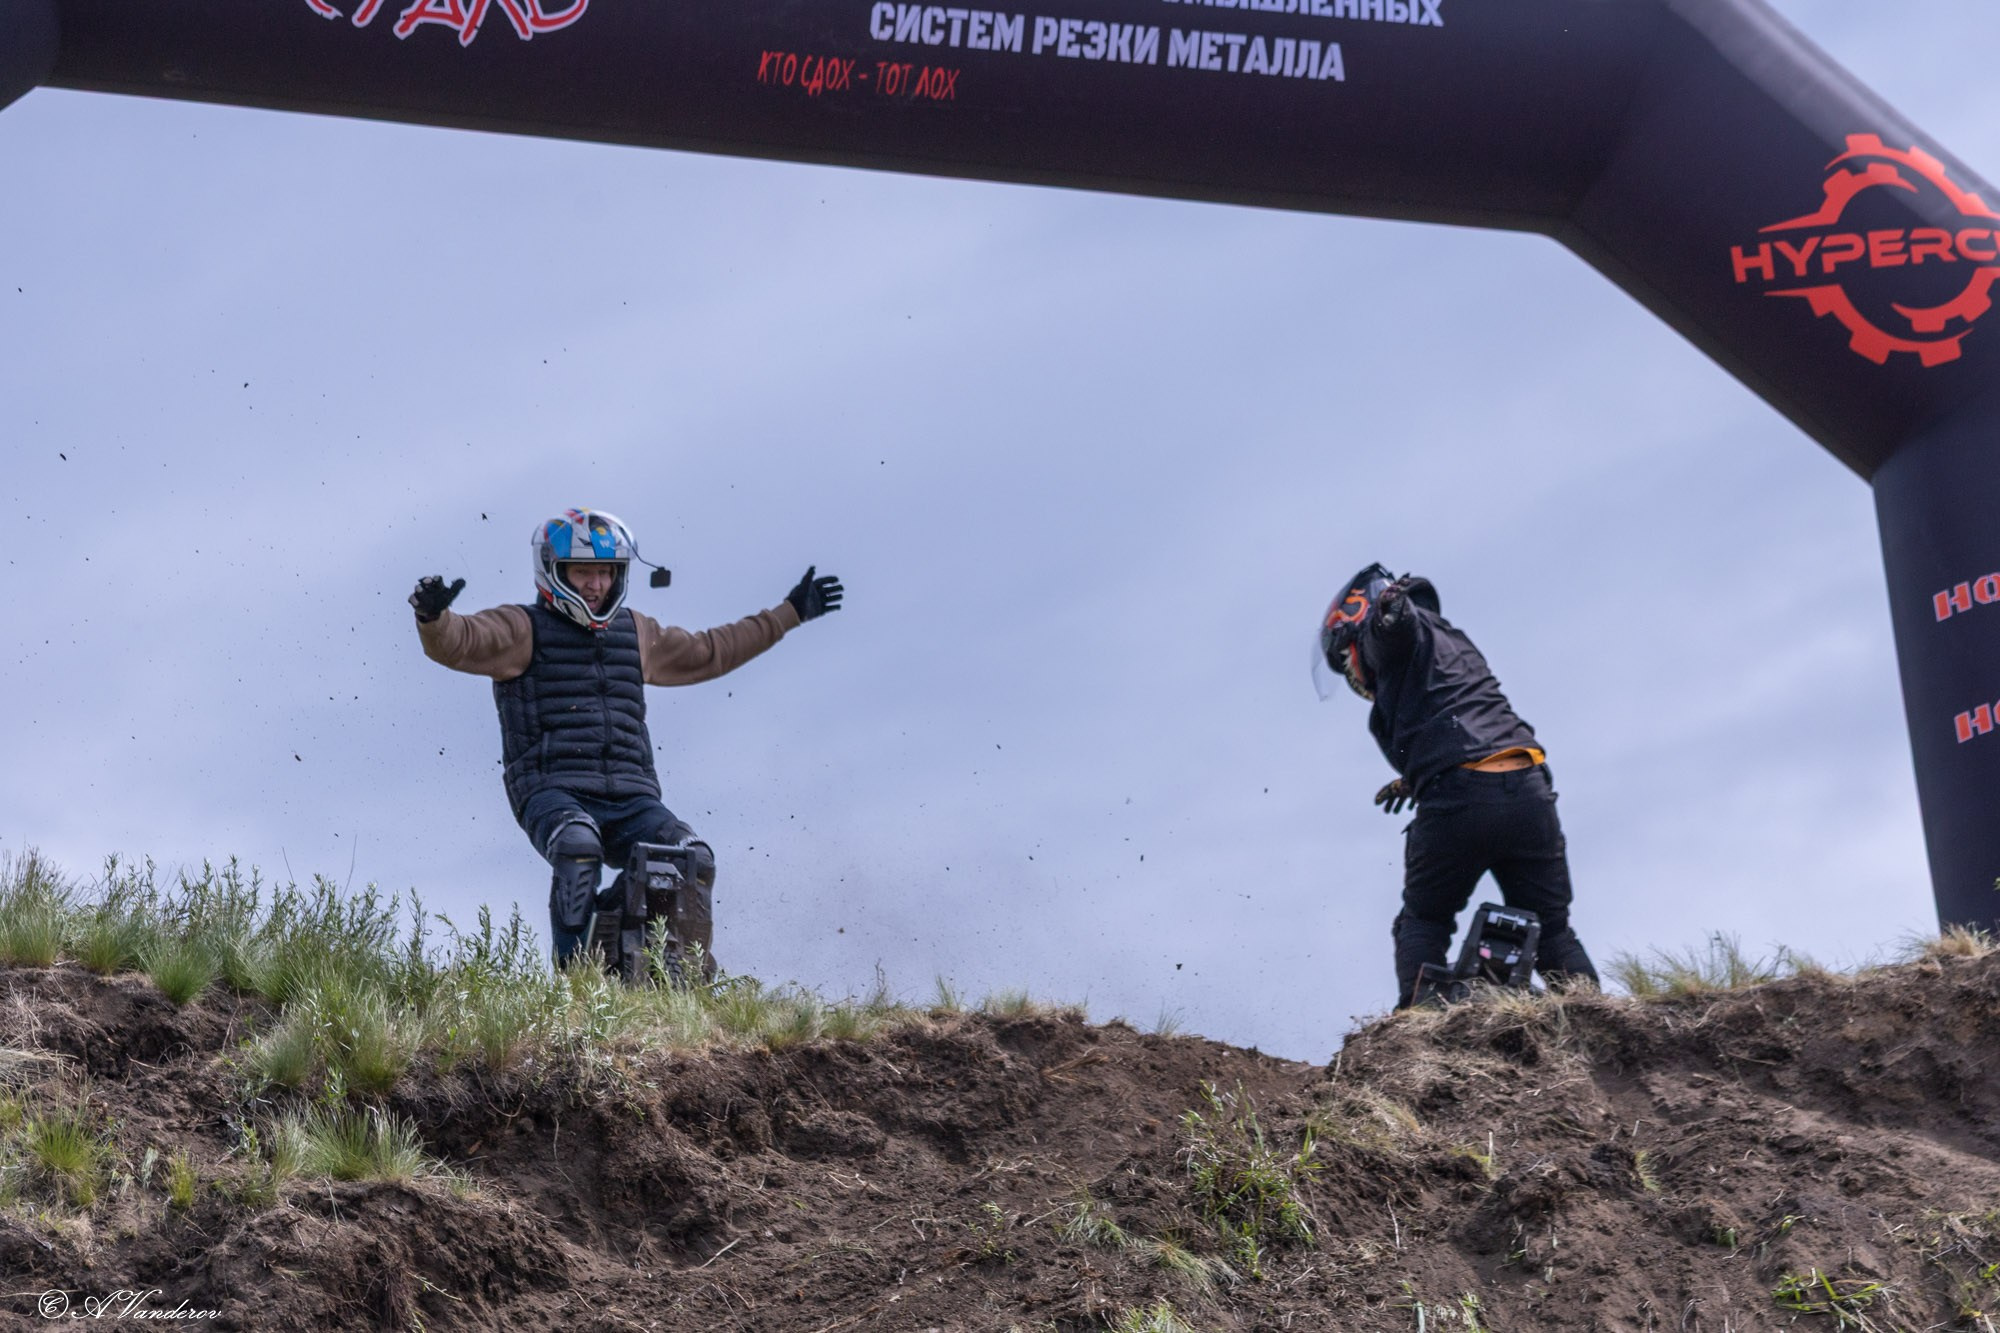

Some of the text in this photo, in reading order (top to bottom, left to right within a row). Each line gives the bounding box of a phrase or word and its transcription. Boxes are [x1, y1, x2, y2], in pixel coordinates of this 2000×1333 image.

[869, 1, 1346, 82] СИСТЕМ РЕЗКИ МЕТАЛЛА
[757, 50, 797, 86] КТО
[800, 55, 855, 96] СДОХ
[876, 61, 914, 96] ТОТ
[915, 66, 960, 100] ЛОХ
[1730, 227, 2000, 283] HYPERC
